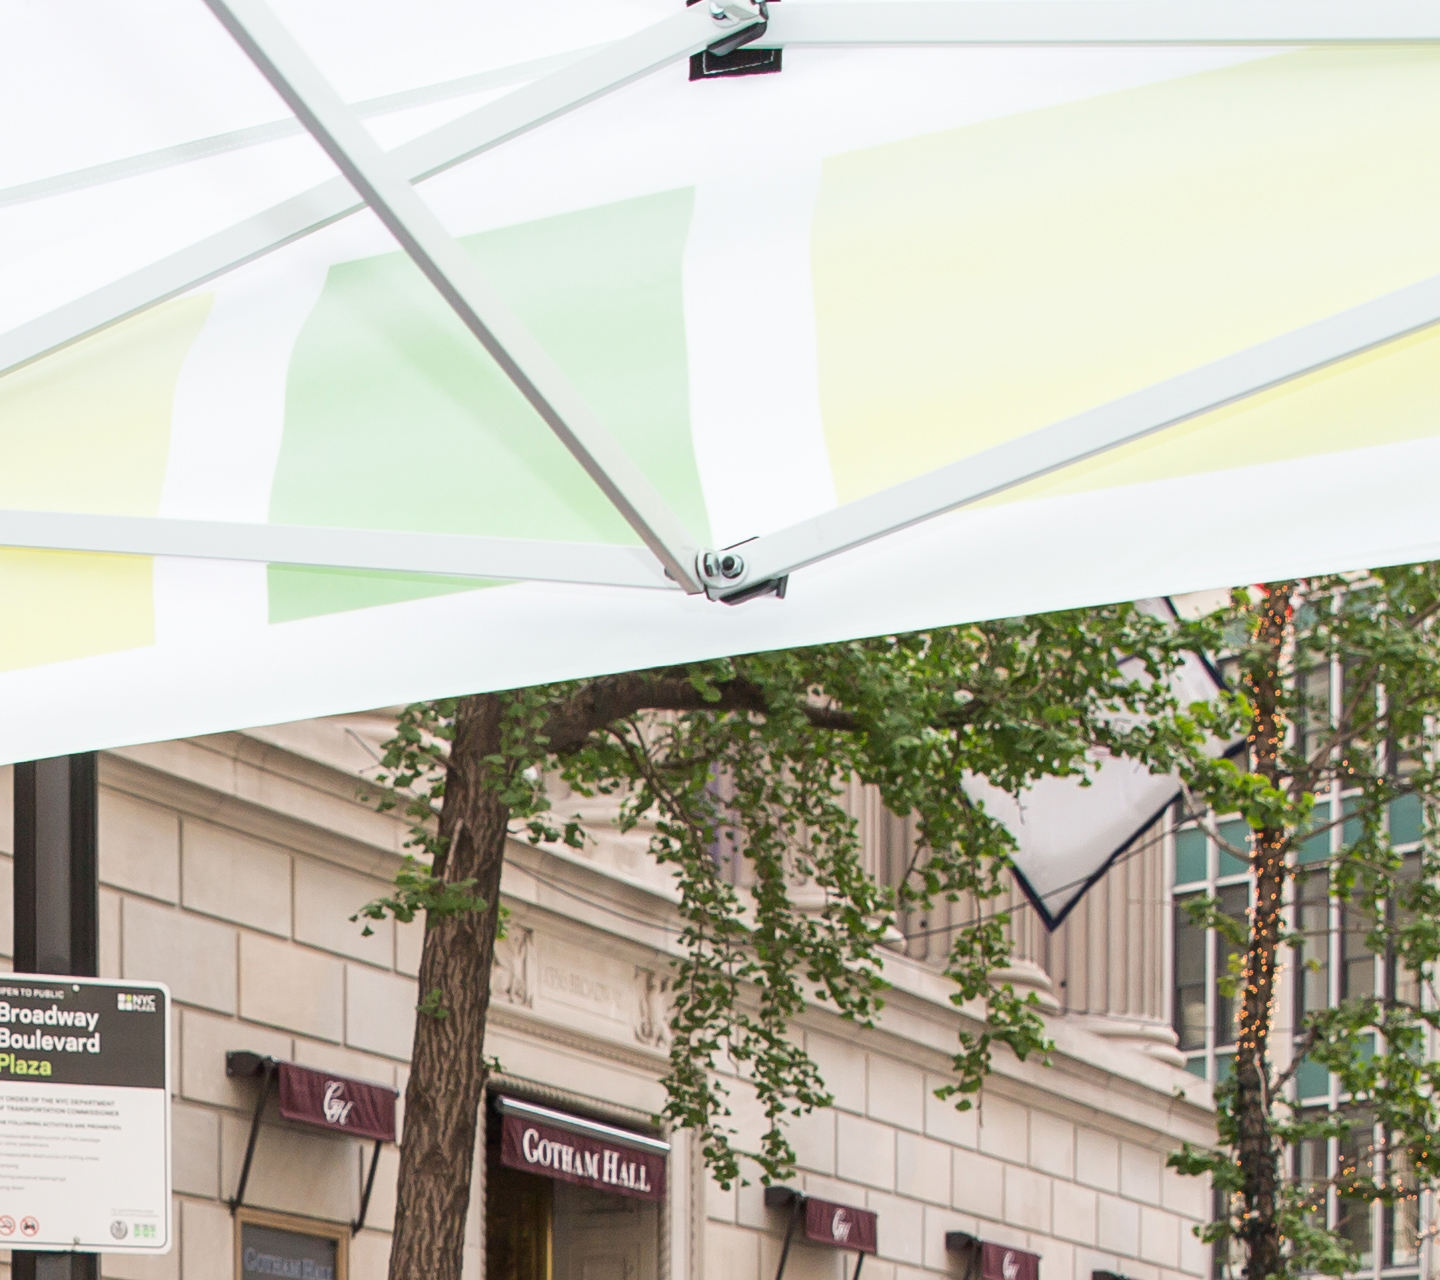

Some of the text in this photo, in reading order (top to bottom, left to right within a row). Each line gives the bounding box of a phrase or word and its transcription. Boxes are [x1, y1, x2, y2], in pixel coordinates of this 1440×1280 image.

[19, 987, 32, 997] TO
[33, 988, 64, 1000] PUBLIC
[523, 1128, 652, 1193] GOTHAM HALL
